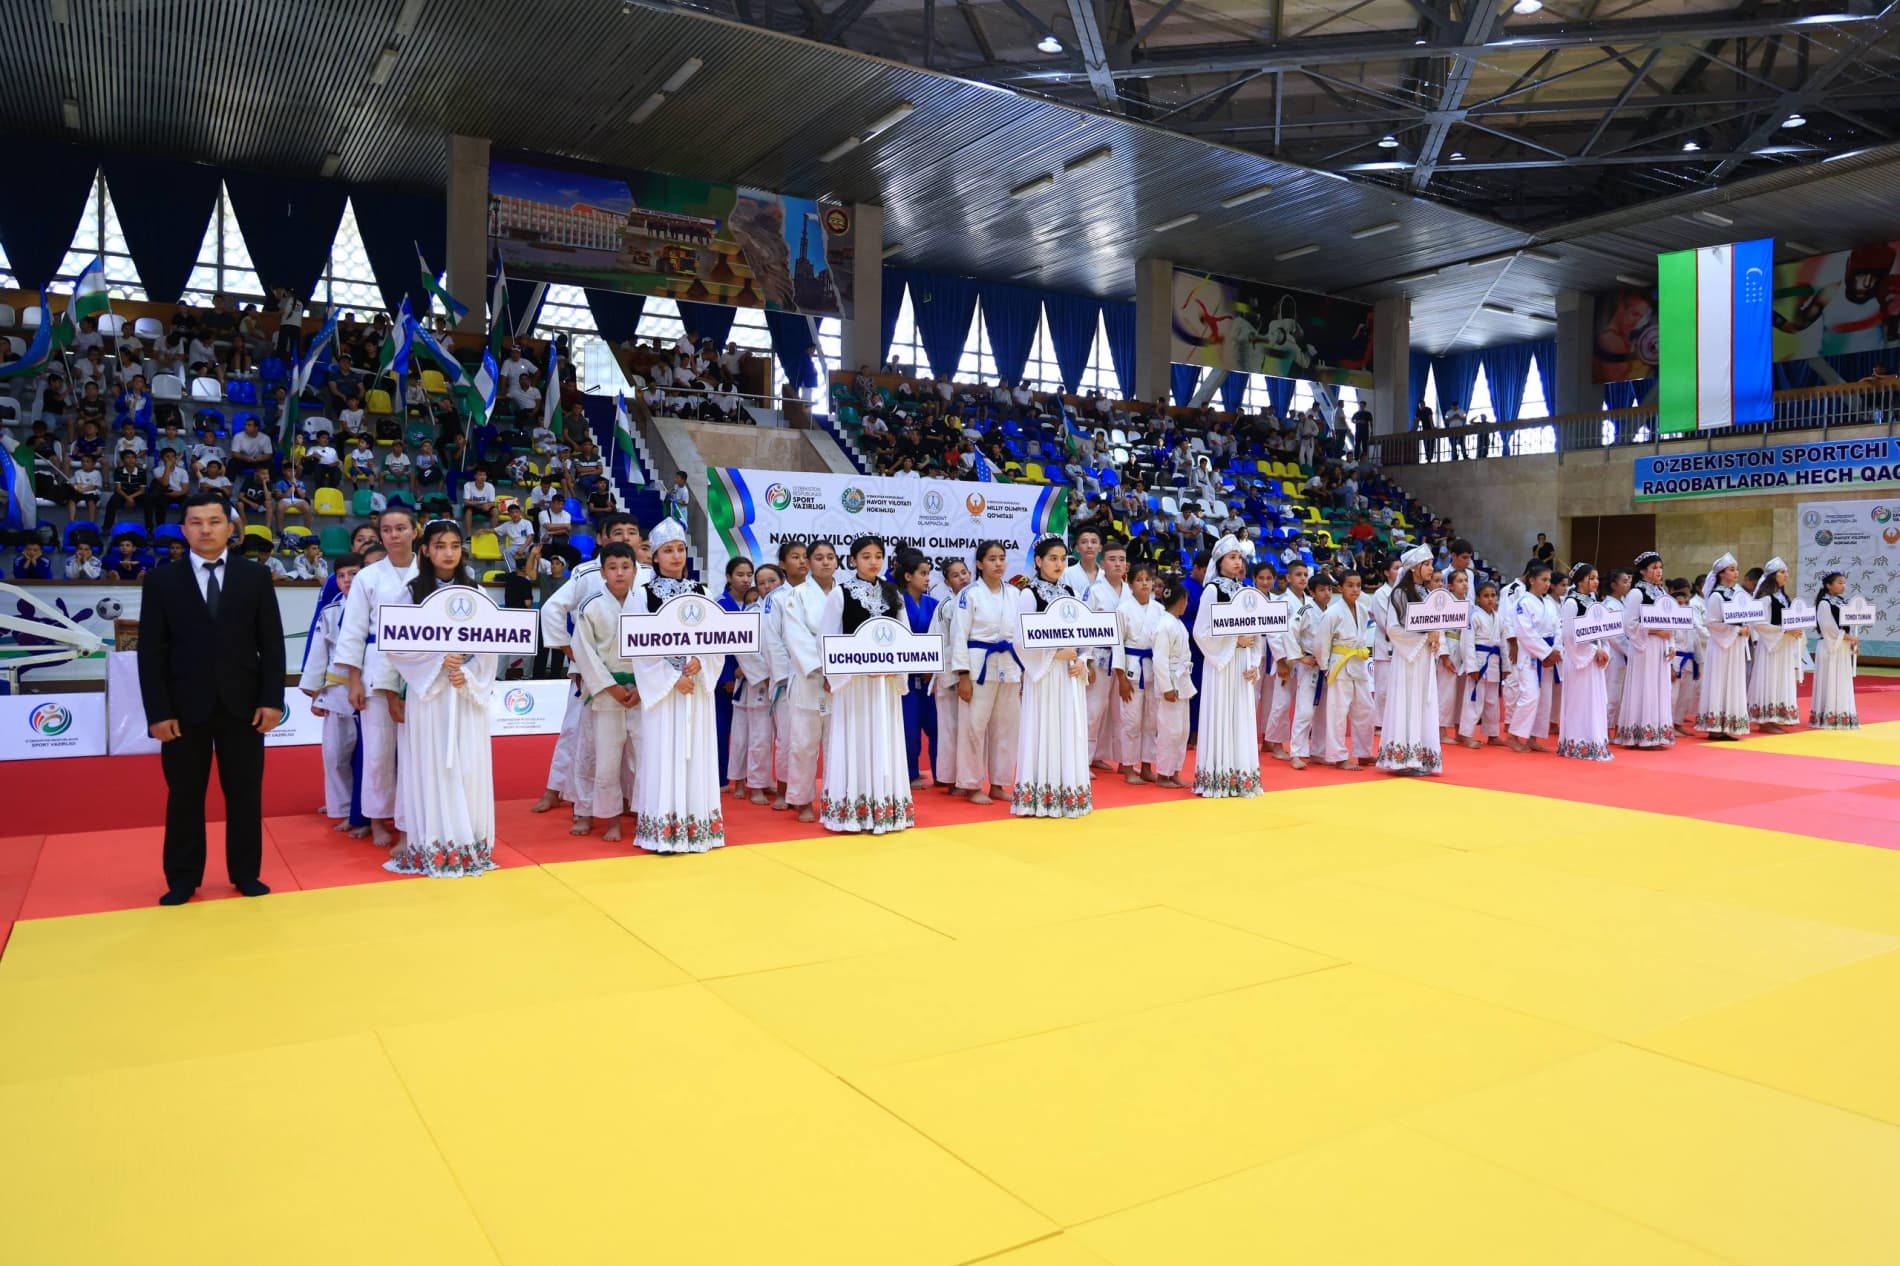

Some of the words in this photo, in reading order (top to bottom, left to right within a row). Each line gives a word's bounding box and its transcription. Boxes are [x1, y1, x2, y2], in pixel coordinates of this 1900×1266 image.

[1781, 441, 1889, 464] SPORTCHI
[1643, 471, 1789, 495] RAQOBATLARDA
[1795, 467, 1853, 485] HECH
[1213, 616, 1256, 628] NAVBAHOR
[1257, 615, 1286, 626] TUMANI
[1409, 614, 1440, 625] XATIRCHI
[1441, 613, 1466, 623] TUMANI
[1643, 616, 1671, 625] KARMANA
[1671, 616, 1693, 625] TUMANI
[383, 624, 454, 642] NAVOIY
[457, 626, 532, 644] SHAHAR
[1027, 628, 1075, 641] KONIMEX
[1077, 627, 1114, 639] TUMANI
[1575, 625, 1602, 637] QIZILTEPA
[1603, 621, 1622, 632] TUMANI
[627, 632, 691, 648] NUROTA
[694, 630, 753, 646] TUMANI
[828, 652, 895, 665] UCHQUDUQ
[897, 651, 939, 663] TUMANI
